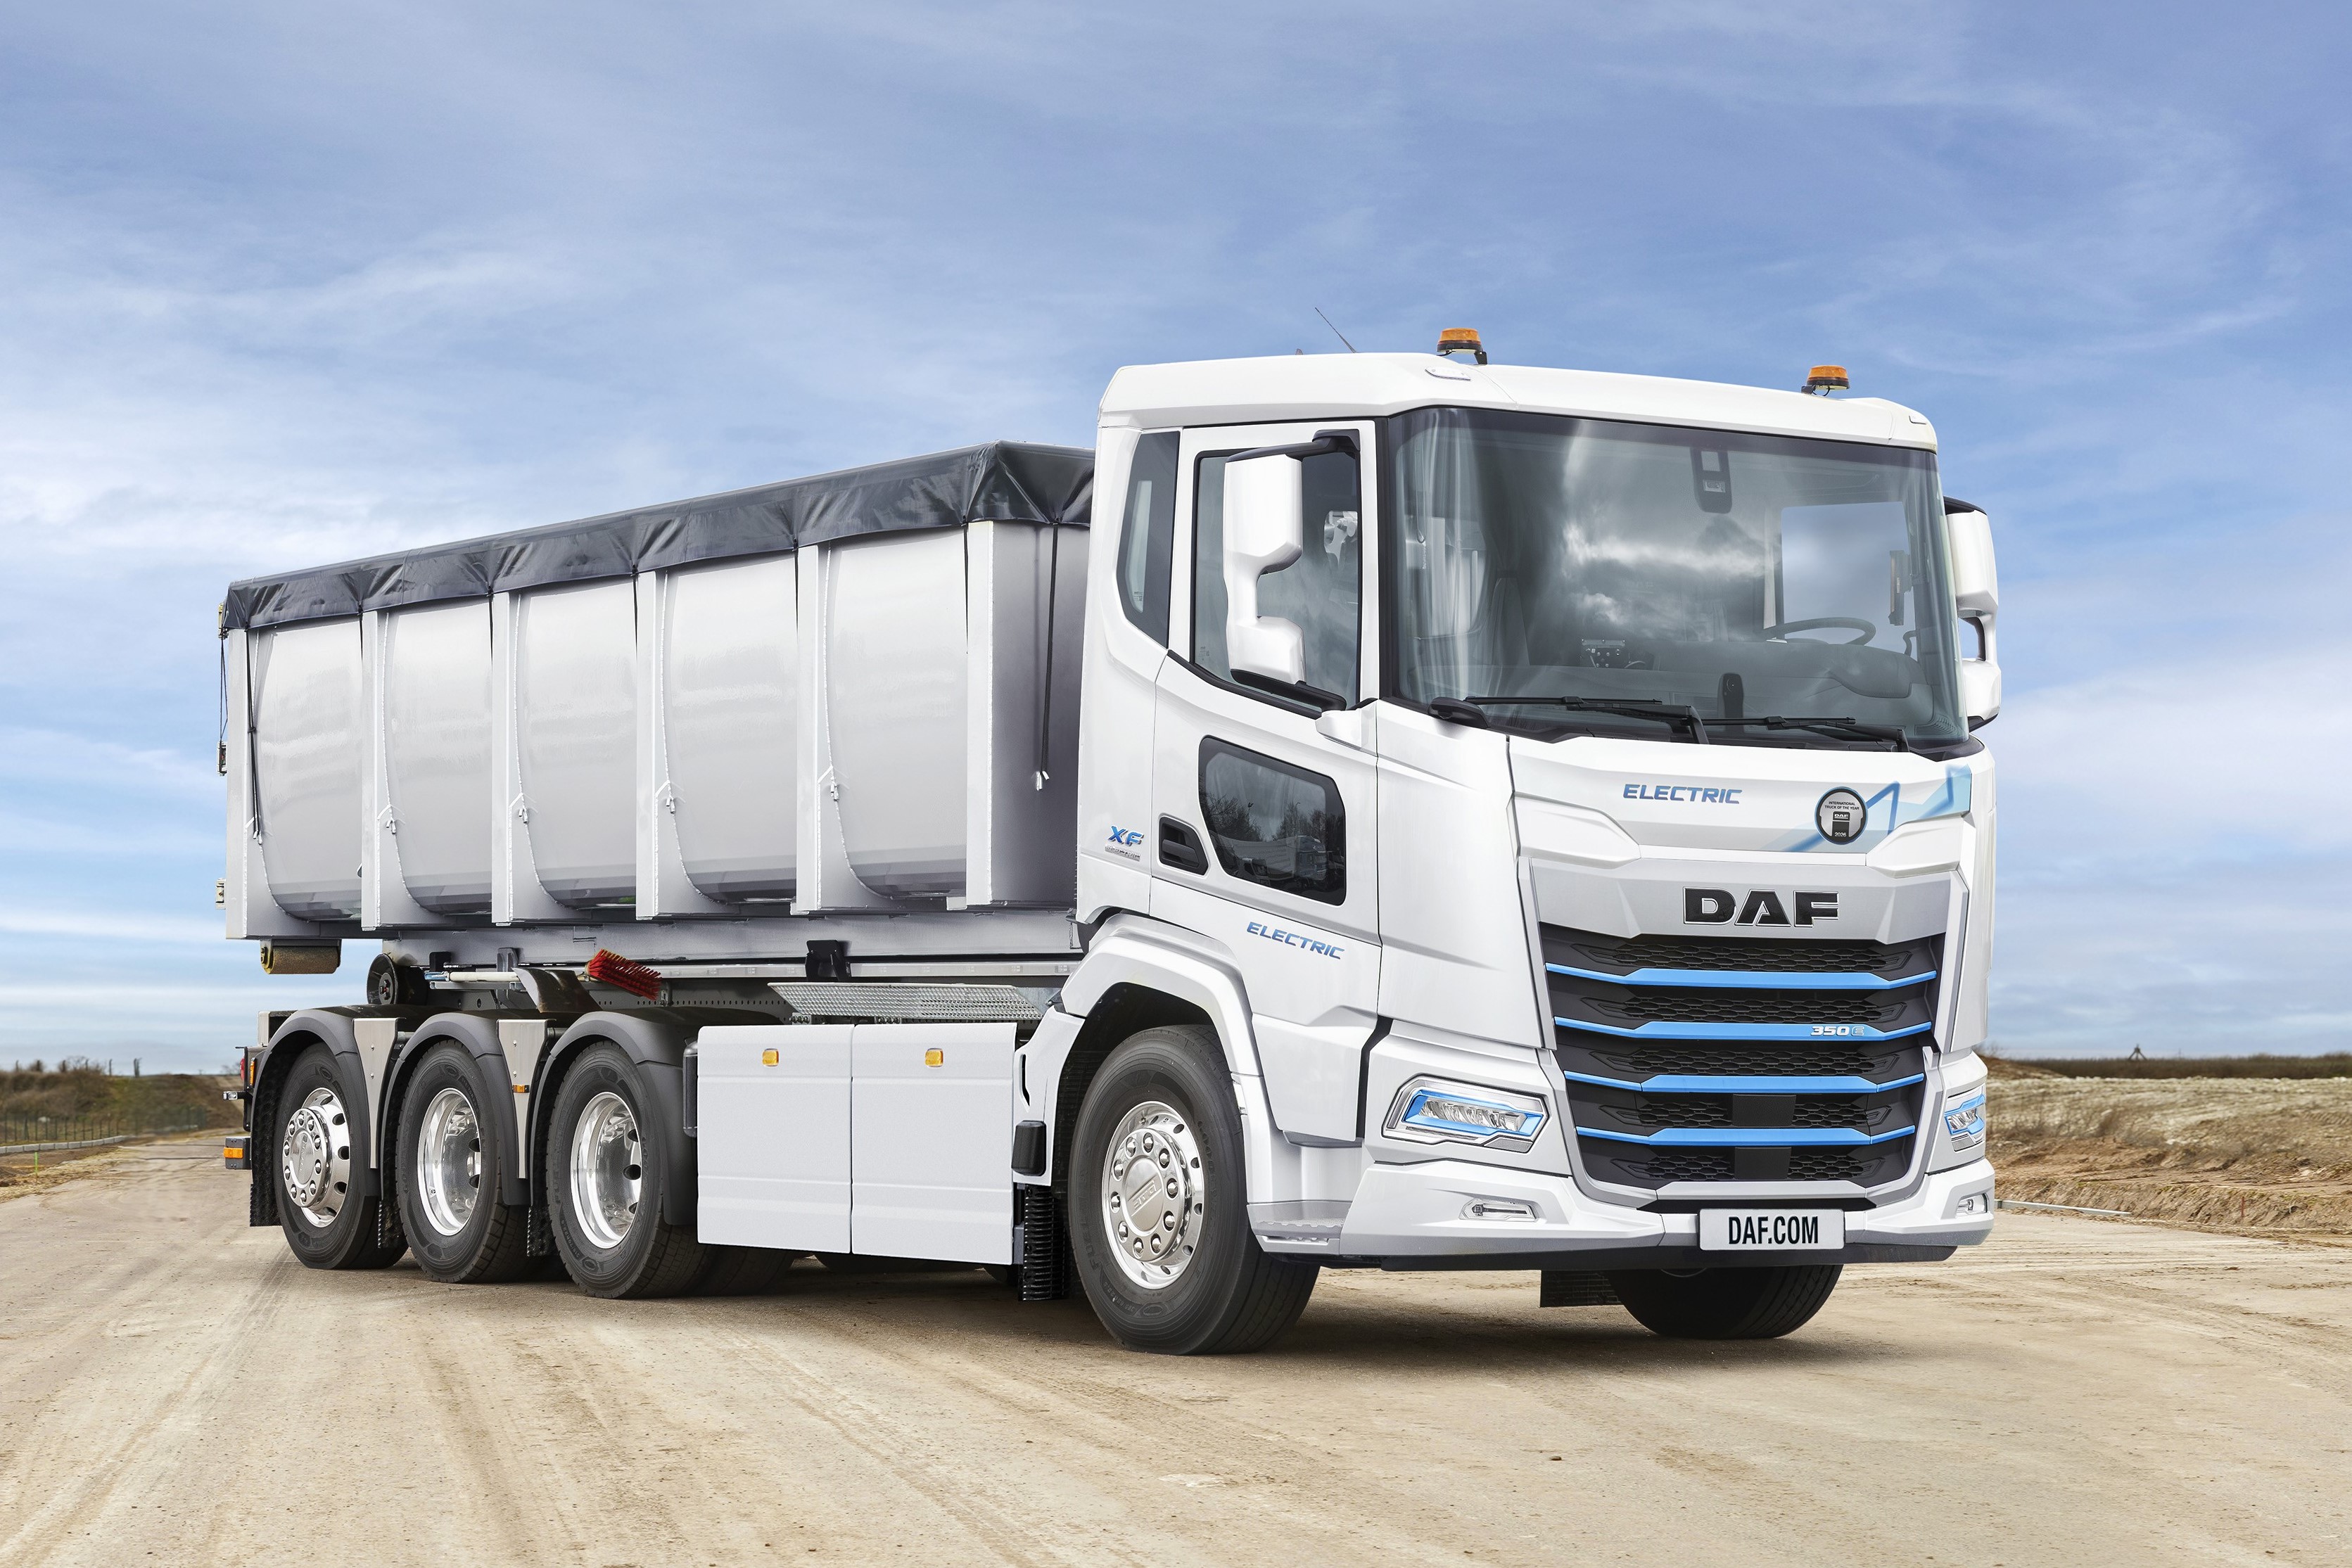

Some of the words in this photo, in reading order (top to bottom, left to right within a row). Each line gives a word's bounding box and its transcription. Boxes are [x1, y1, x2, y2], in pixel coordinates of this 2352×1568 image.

[1622, 784, 1743, 805] ELECTRIC
[1107, 825, 1145, 847] XF
[1683, 886, 1839, 928] DAF
[1246, 922, 1345, 960] ELECTRIC
[1728, 1216, 1819, 1244] DAF.COM
